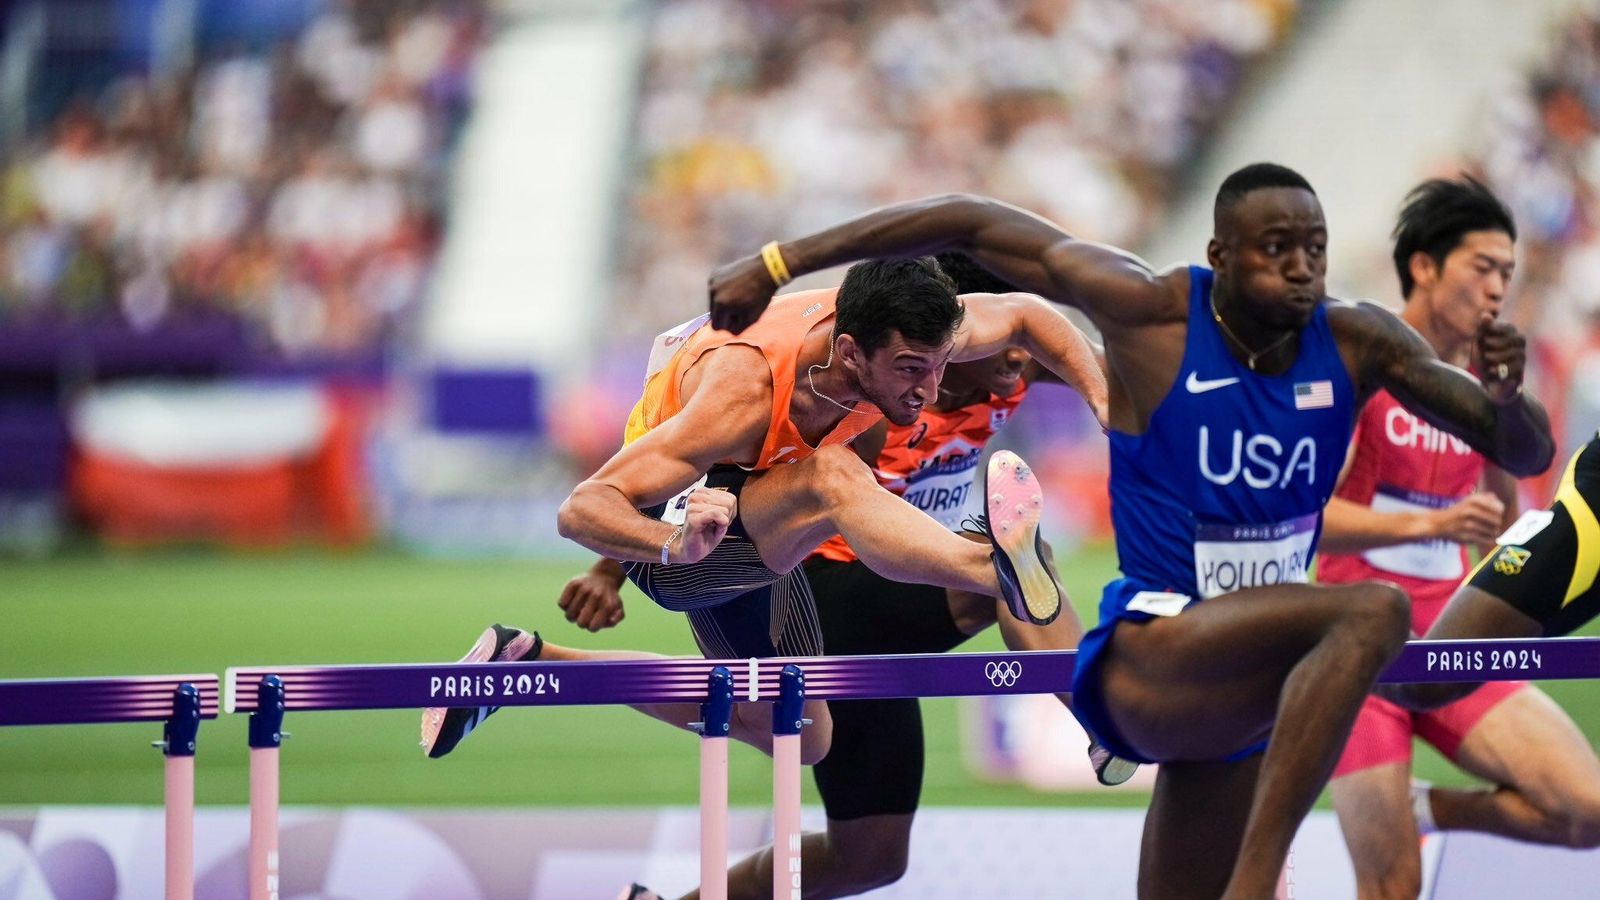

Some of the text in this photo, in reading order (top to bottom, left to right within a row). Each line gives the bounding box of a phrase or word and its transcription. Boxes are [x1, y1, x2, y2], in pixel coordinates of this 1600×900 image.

[1385, 406, 1472, 455] CHIN
[1199, 424, 1317, 490] USA
[1490, 649, 1541, 670] 2024
[503, 673, 560, 696] 2024
